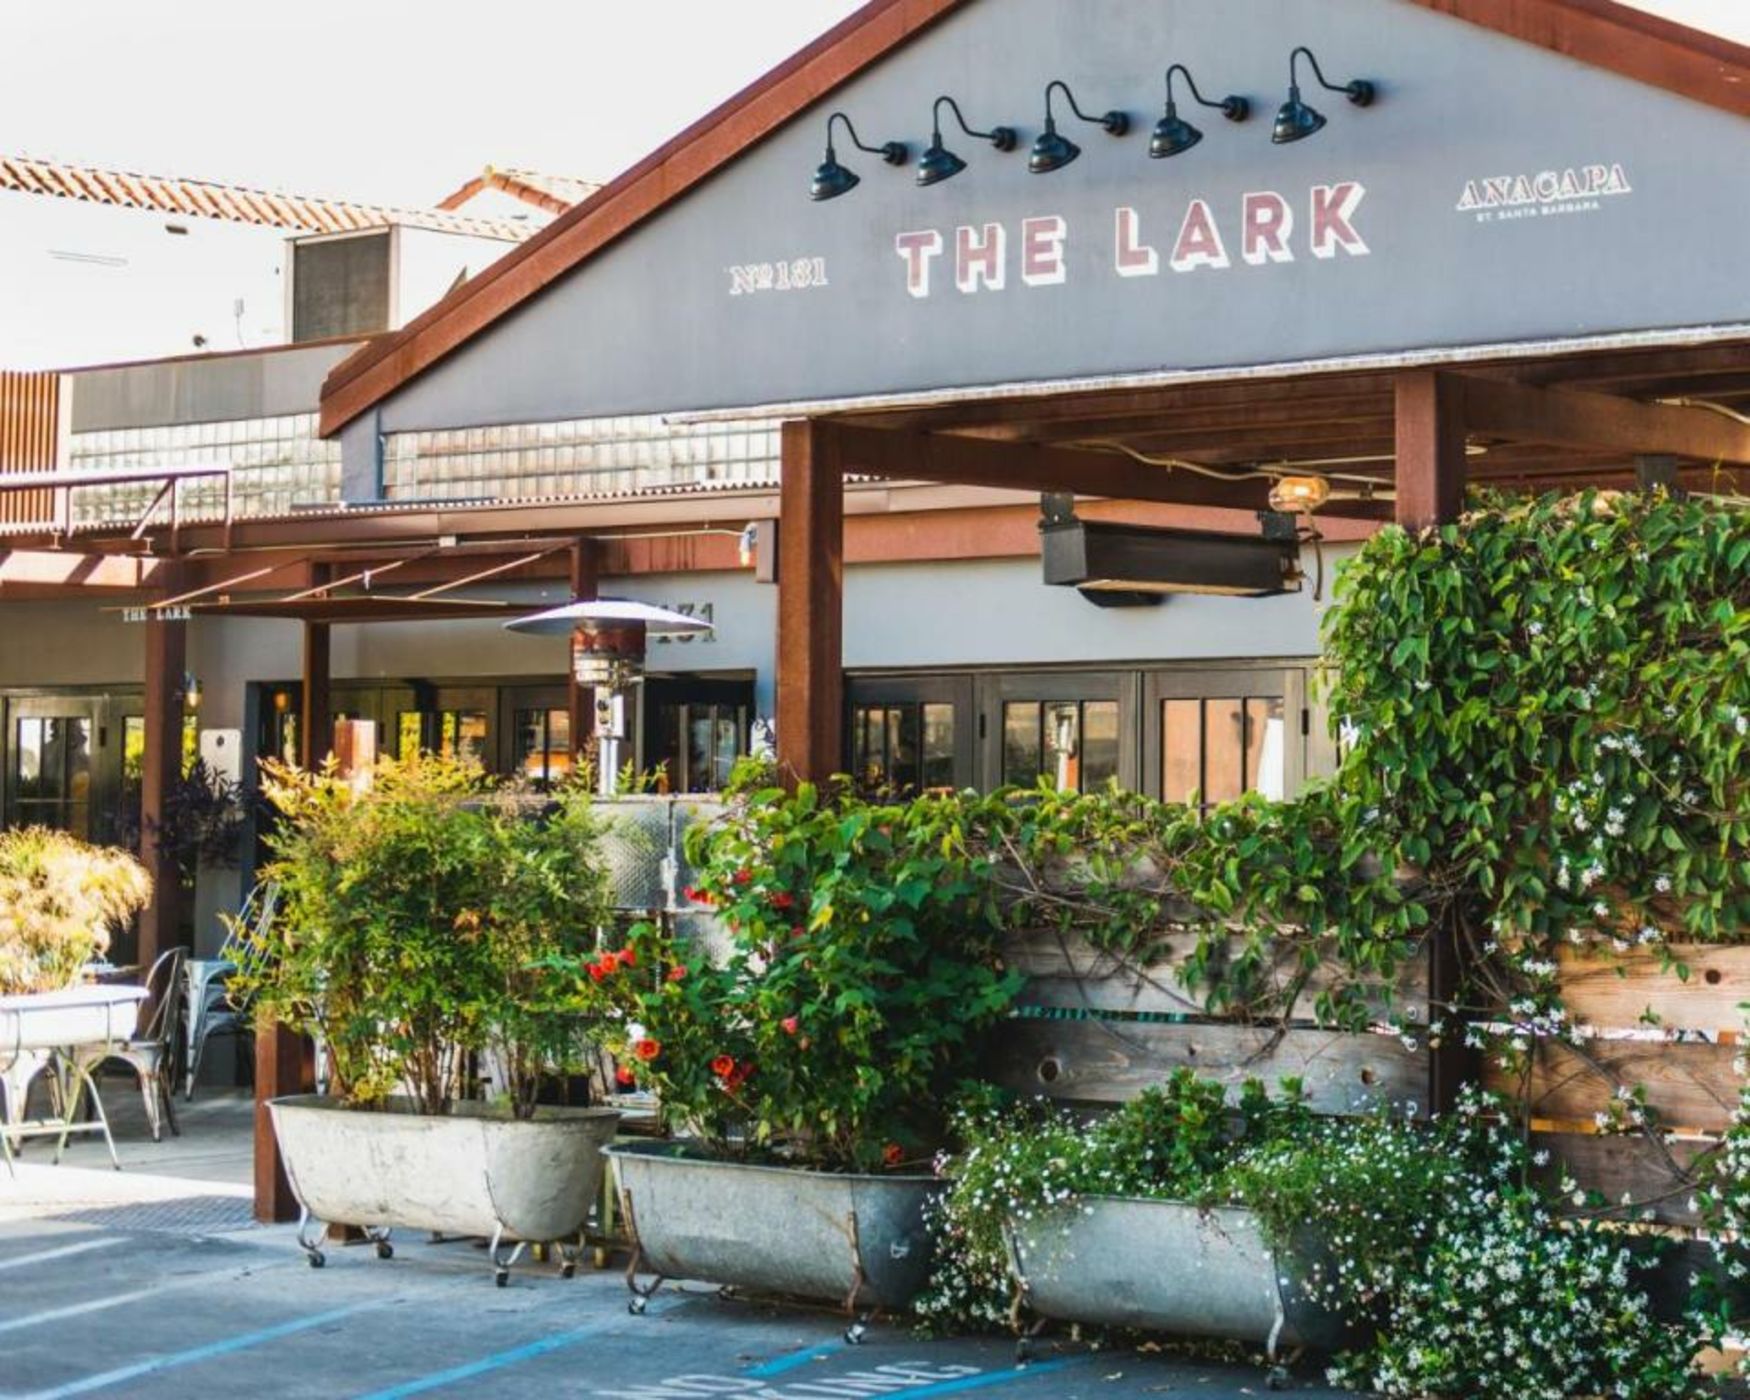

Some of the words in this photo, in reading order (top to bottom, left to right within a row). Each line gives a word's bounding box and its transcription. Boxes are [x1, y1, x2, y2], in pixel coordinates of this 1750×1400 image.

[1456, 163, 1632, 210] ANACAPA
[896, 215, 1067, 298] THE
[1115, 181, 1371, 278] LARK
[122, 606, 147, 622] THE
[156, 604, 191, 621] LARK
